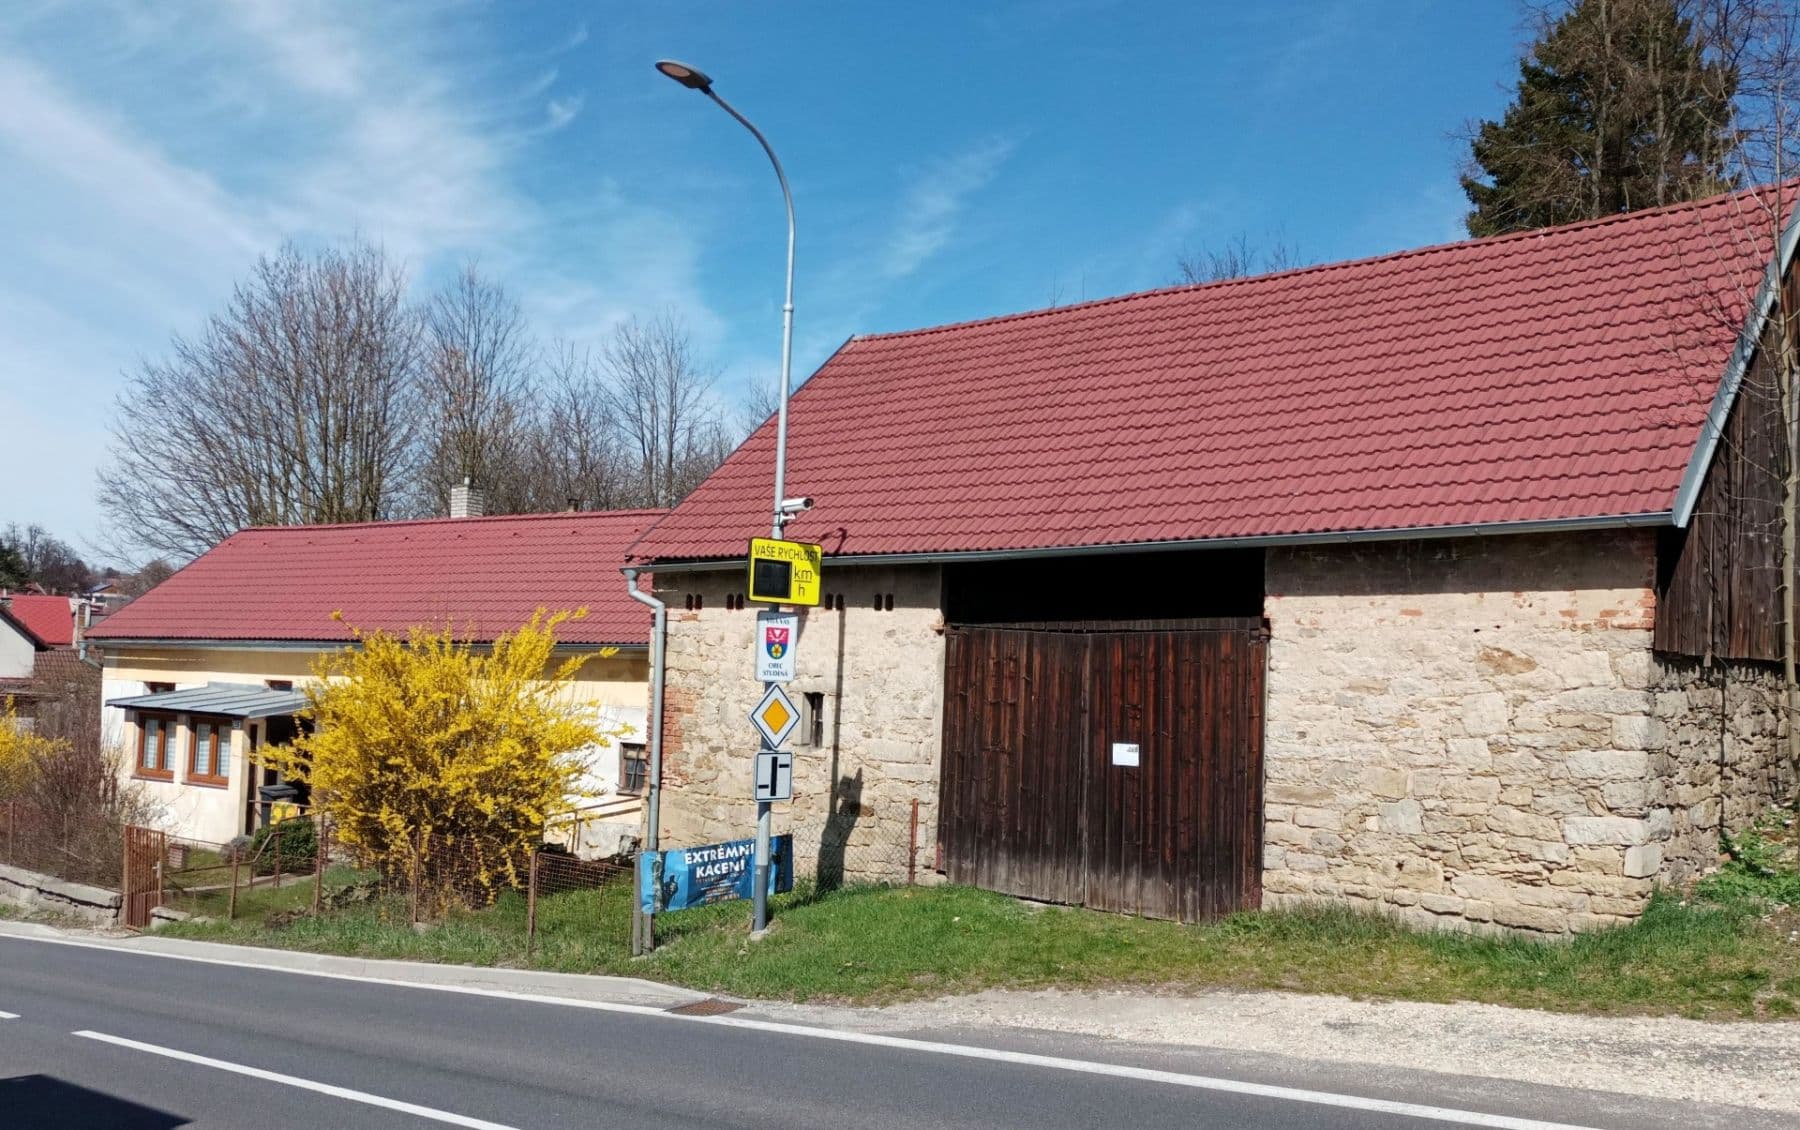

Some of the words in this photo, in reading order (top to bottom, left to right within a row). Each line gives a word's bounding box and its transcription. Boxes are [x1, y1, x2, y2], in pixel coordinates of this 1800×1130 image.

[754, 543, 775, 557] VAŠE
[794, 565, 813, 580] km
[798, 583, 806, 597] h
[696, 857, 745, 878] KÁCENÍ
